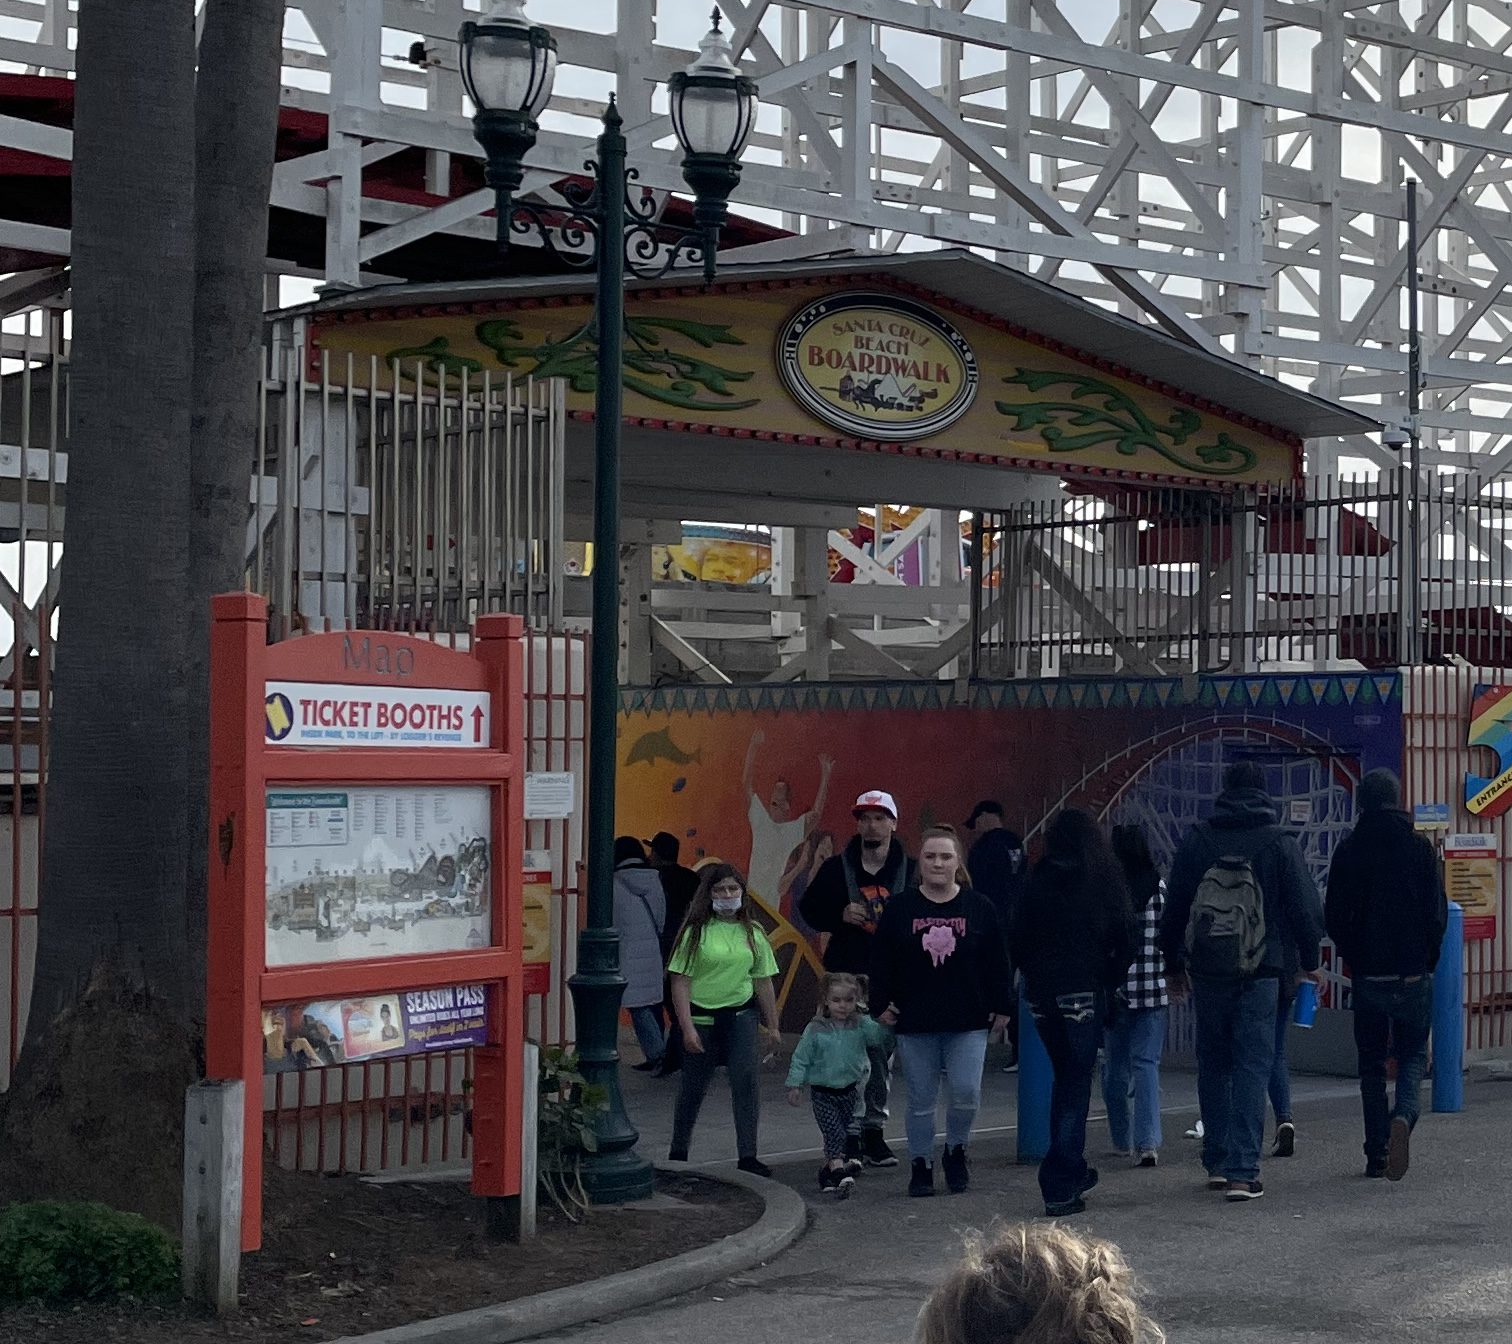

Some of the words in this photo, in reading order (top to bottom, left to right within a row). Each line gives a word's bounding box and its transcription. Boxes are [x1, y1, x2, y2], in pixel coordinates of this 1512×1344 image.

[832, 319, 883, 336] SANTA
[888, 323, 931, 348] CRUZ
[854, 335, 909, 356] BEACH
[808, 344, 950, 384] BOARDWALK
[342, 634, 414, 679] Map
[299, 699, 371, 728] TICKET
[376, 702, 463, 731] BOOTHS
[406, 989, 453, 1013] SEASON
[456, 985, 484, 1007] PASS
